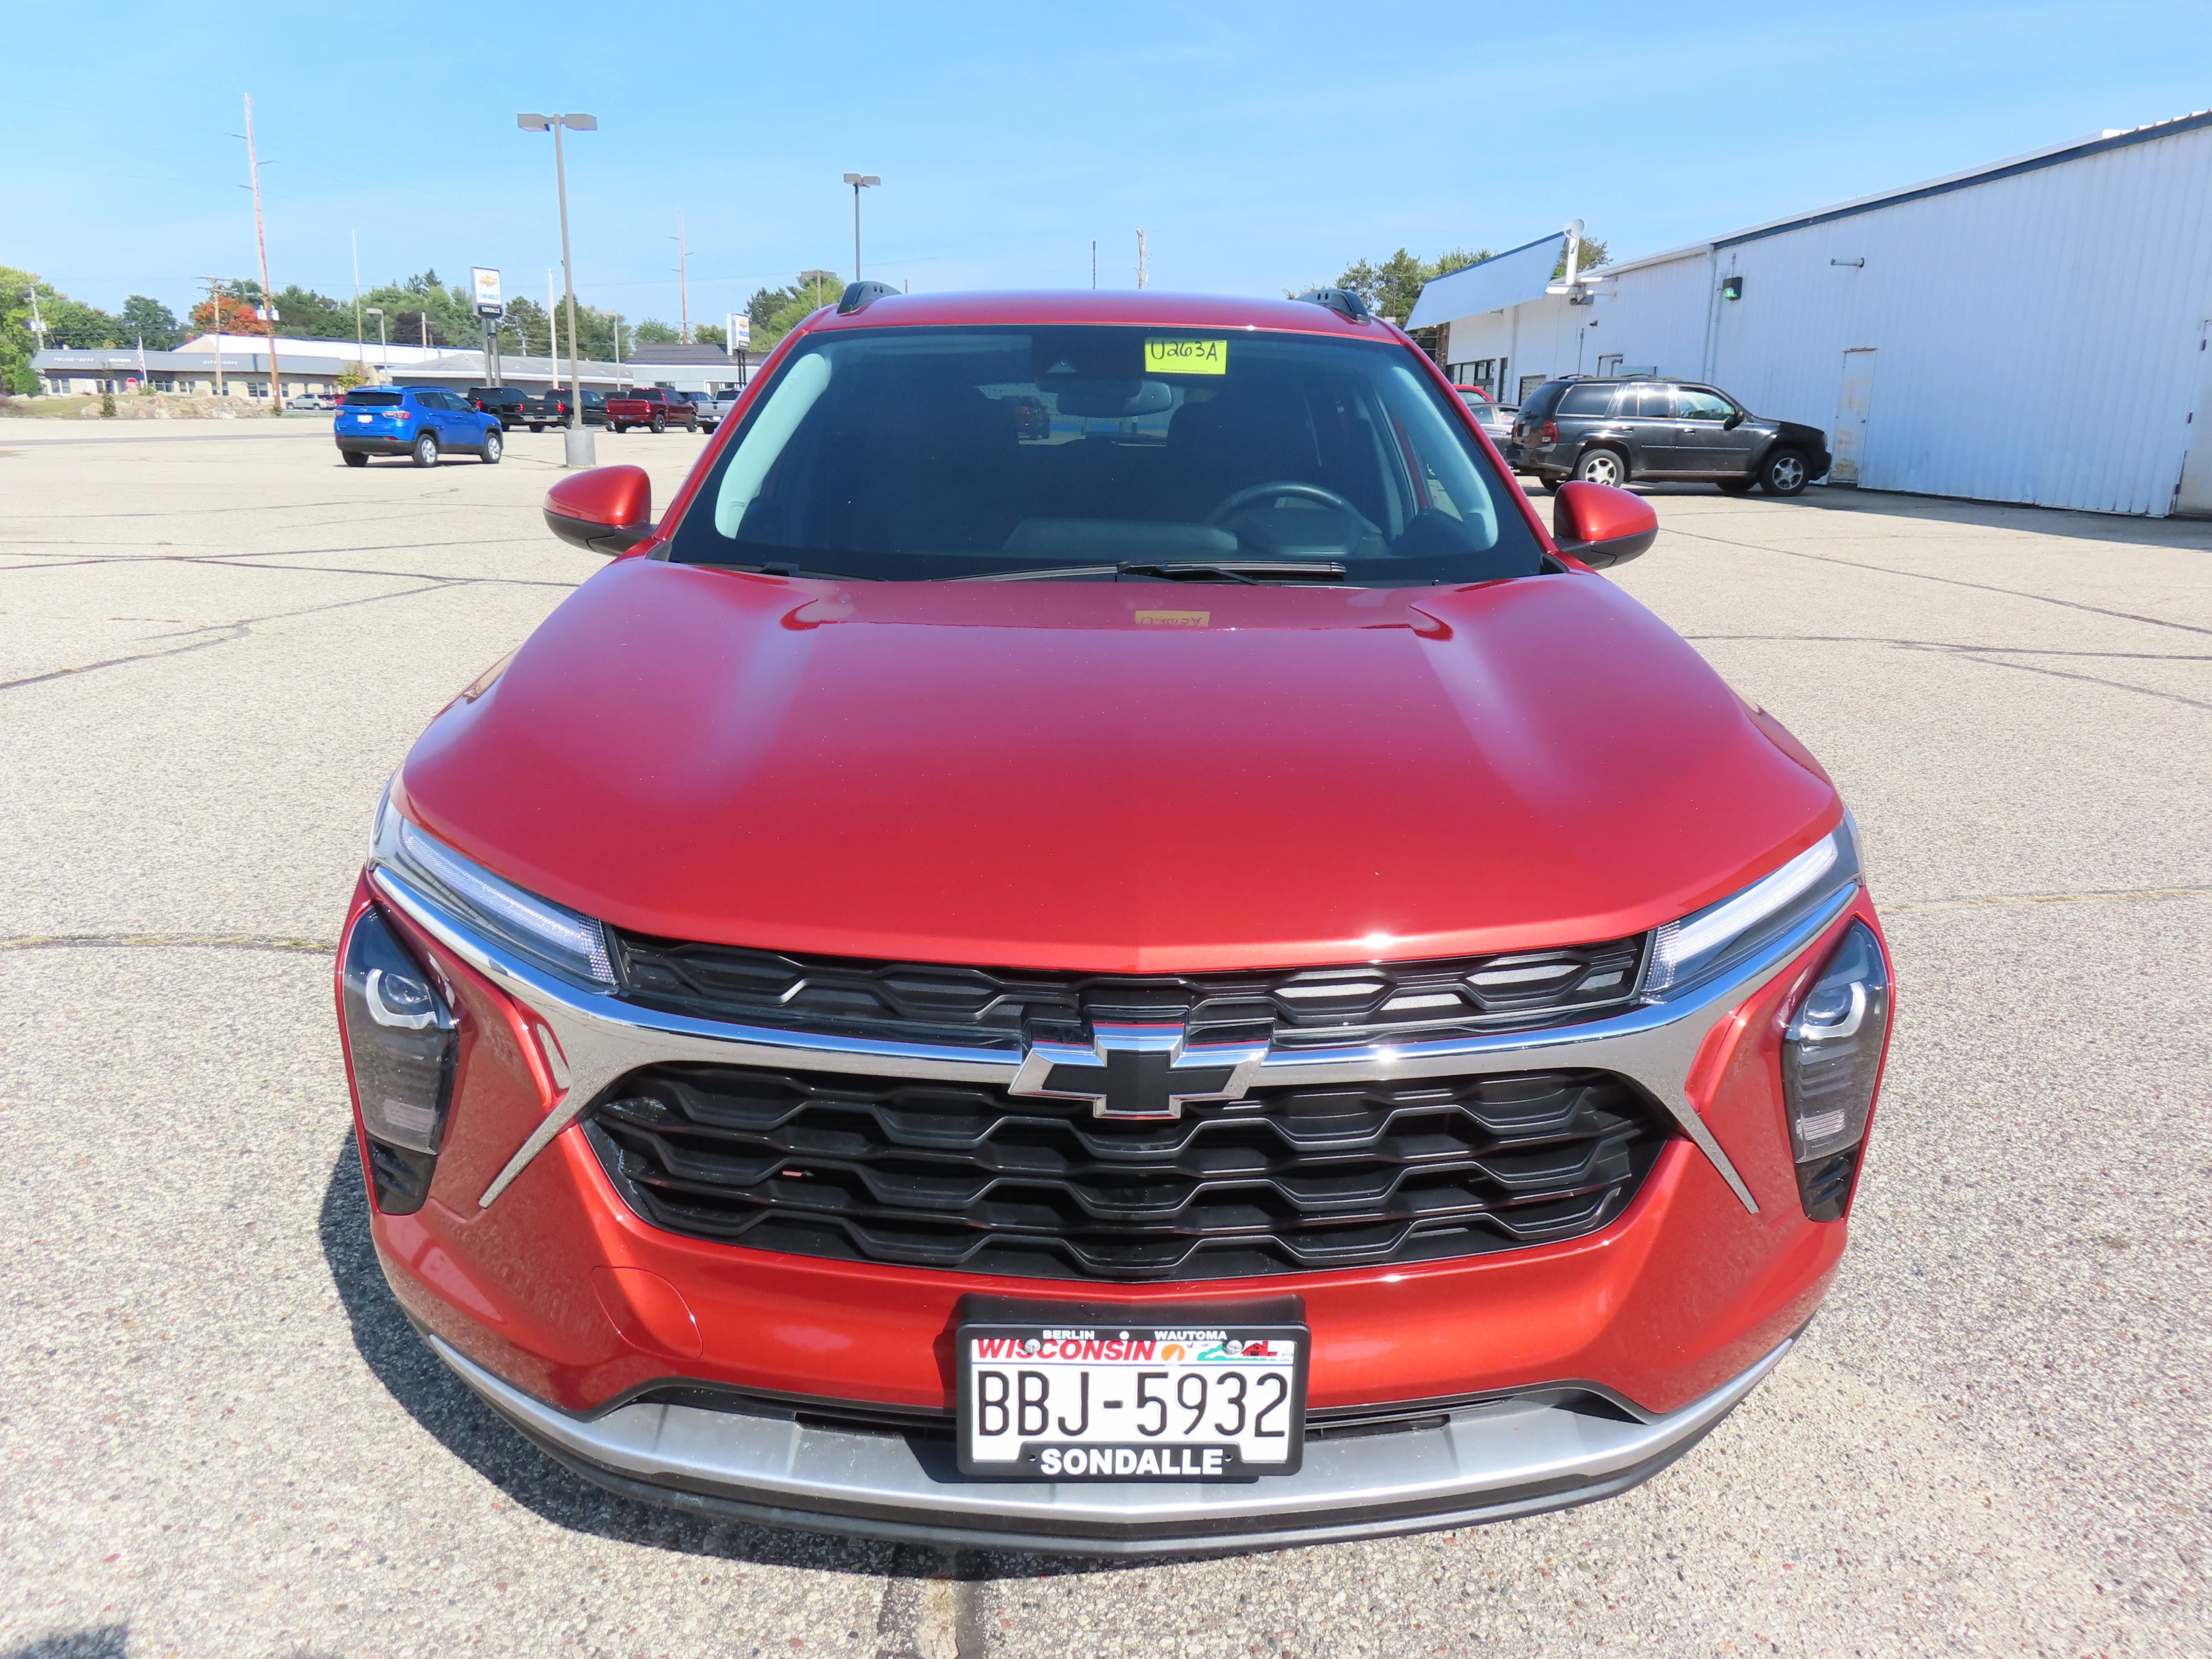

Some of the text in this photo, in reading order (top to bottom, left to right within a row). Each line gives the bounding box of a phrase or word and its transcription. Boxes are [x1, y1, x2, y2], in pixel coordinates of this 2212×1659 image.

[1151, 341, 1217, 361] U263A
[1043, 1330, 1228, 1341] BERLIN WAUTOMA
[977, 1339, 1155, 1361] WISCONSIN
[978, 1371, 1288, 1437] BBJ-5932
[1040, 1449, 1223, 1476] SONDALLE
